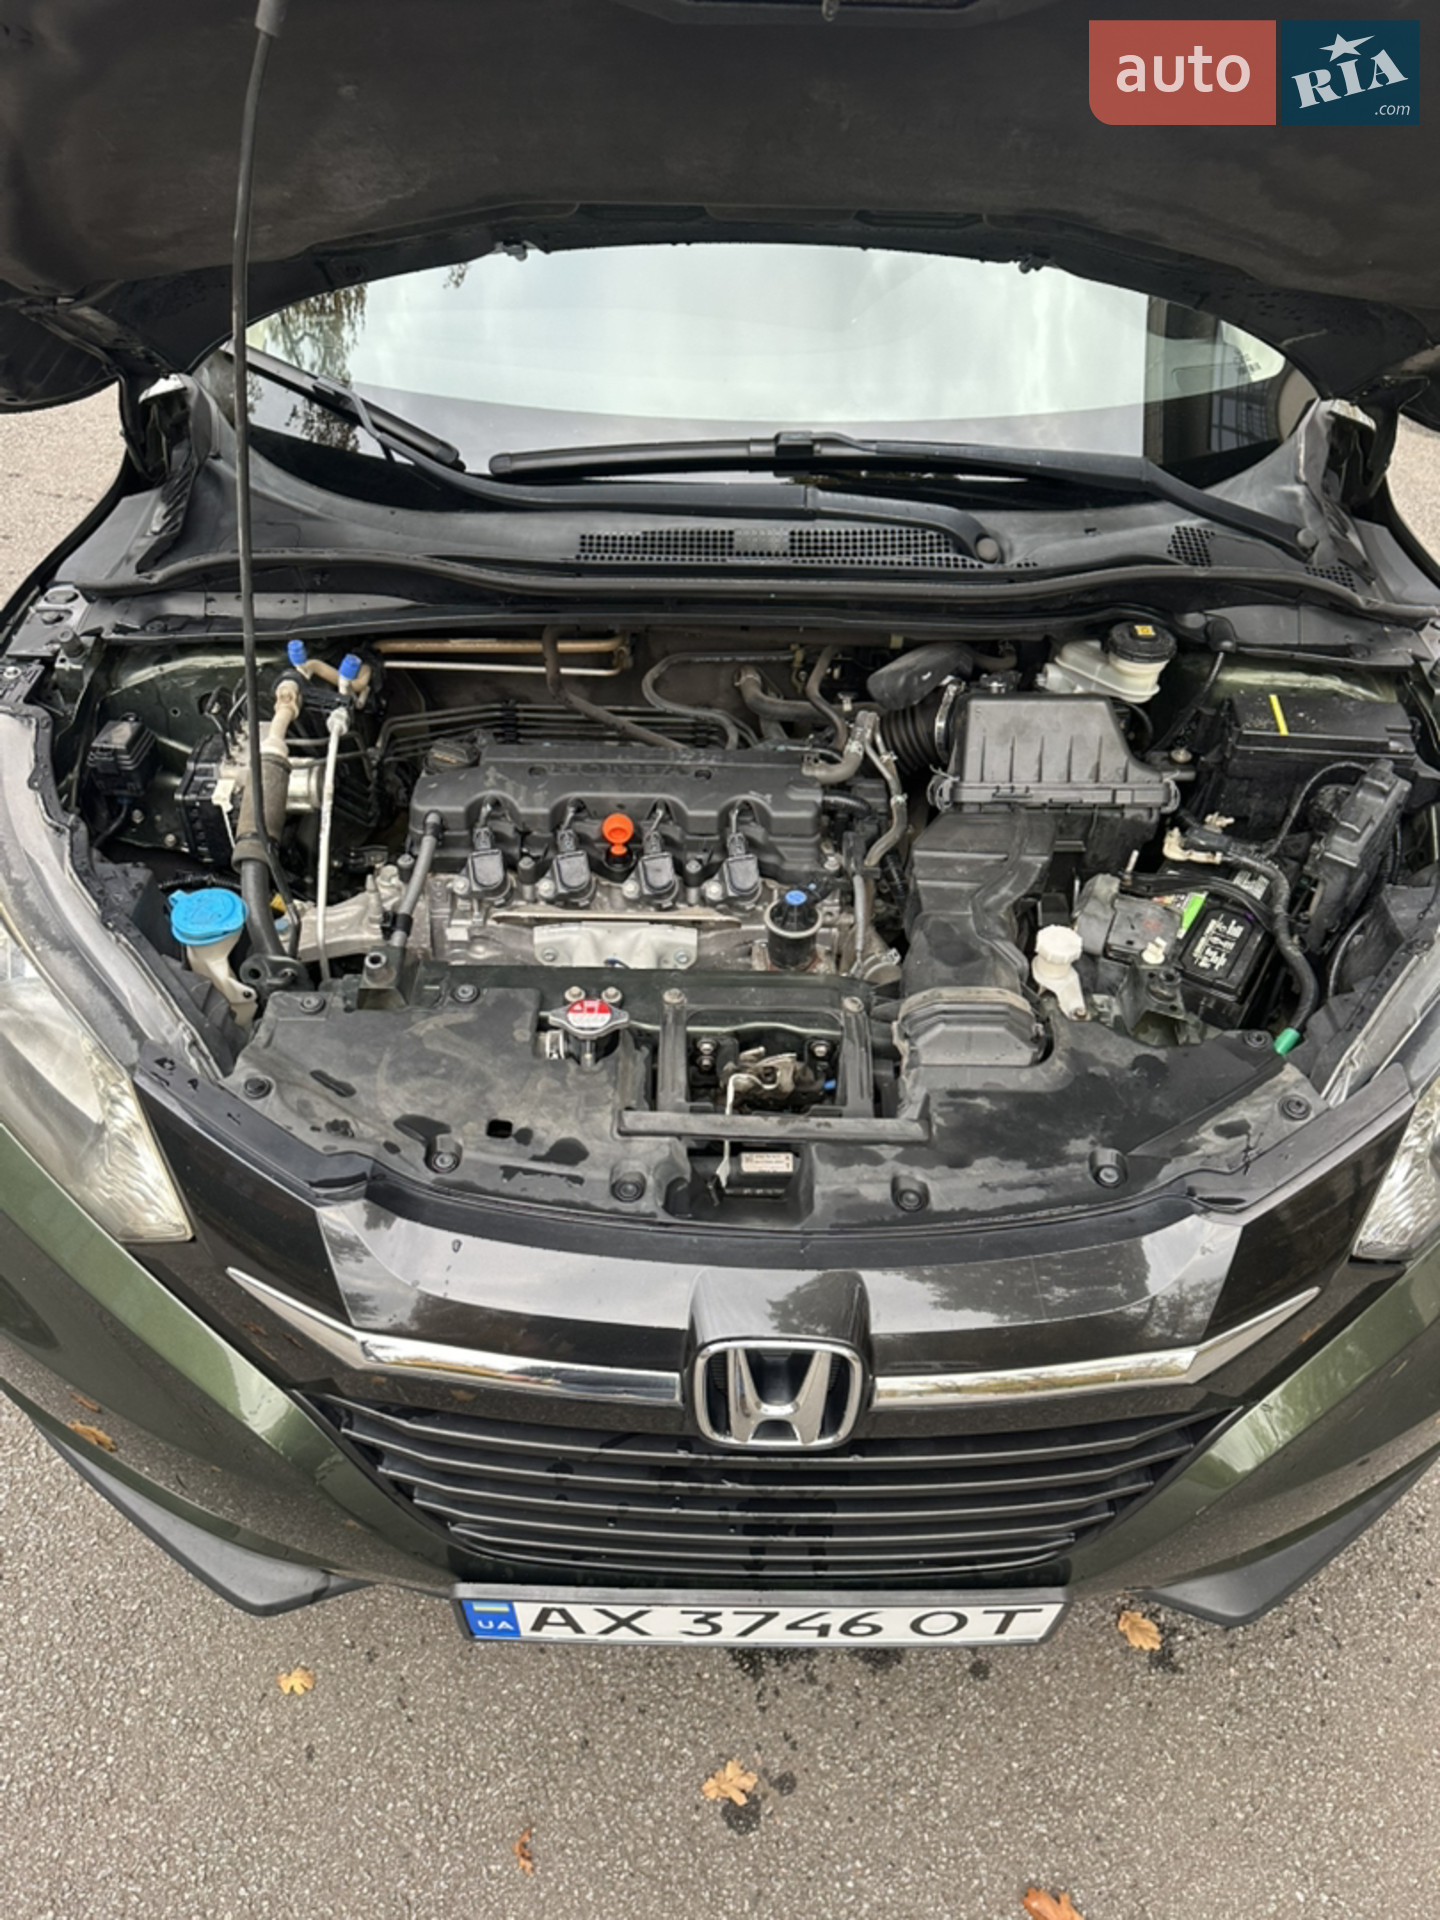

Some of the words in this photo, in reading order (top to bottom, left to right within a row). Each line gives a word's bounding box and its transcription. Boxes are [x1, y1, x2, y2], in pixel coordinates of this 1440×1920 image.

[477, 1619, 515, 1631] UA
[530, 1606, 652, 1636] AX
[679, 1609, 884, 1638] 3746
[909, 1608, 1044, 1637] OT
